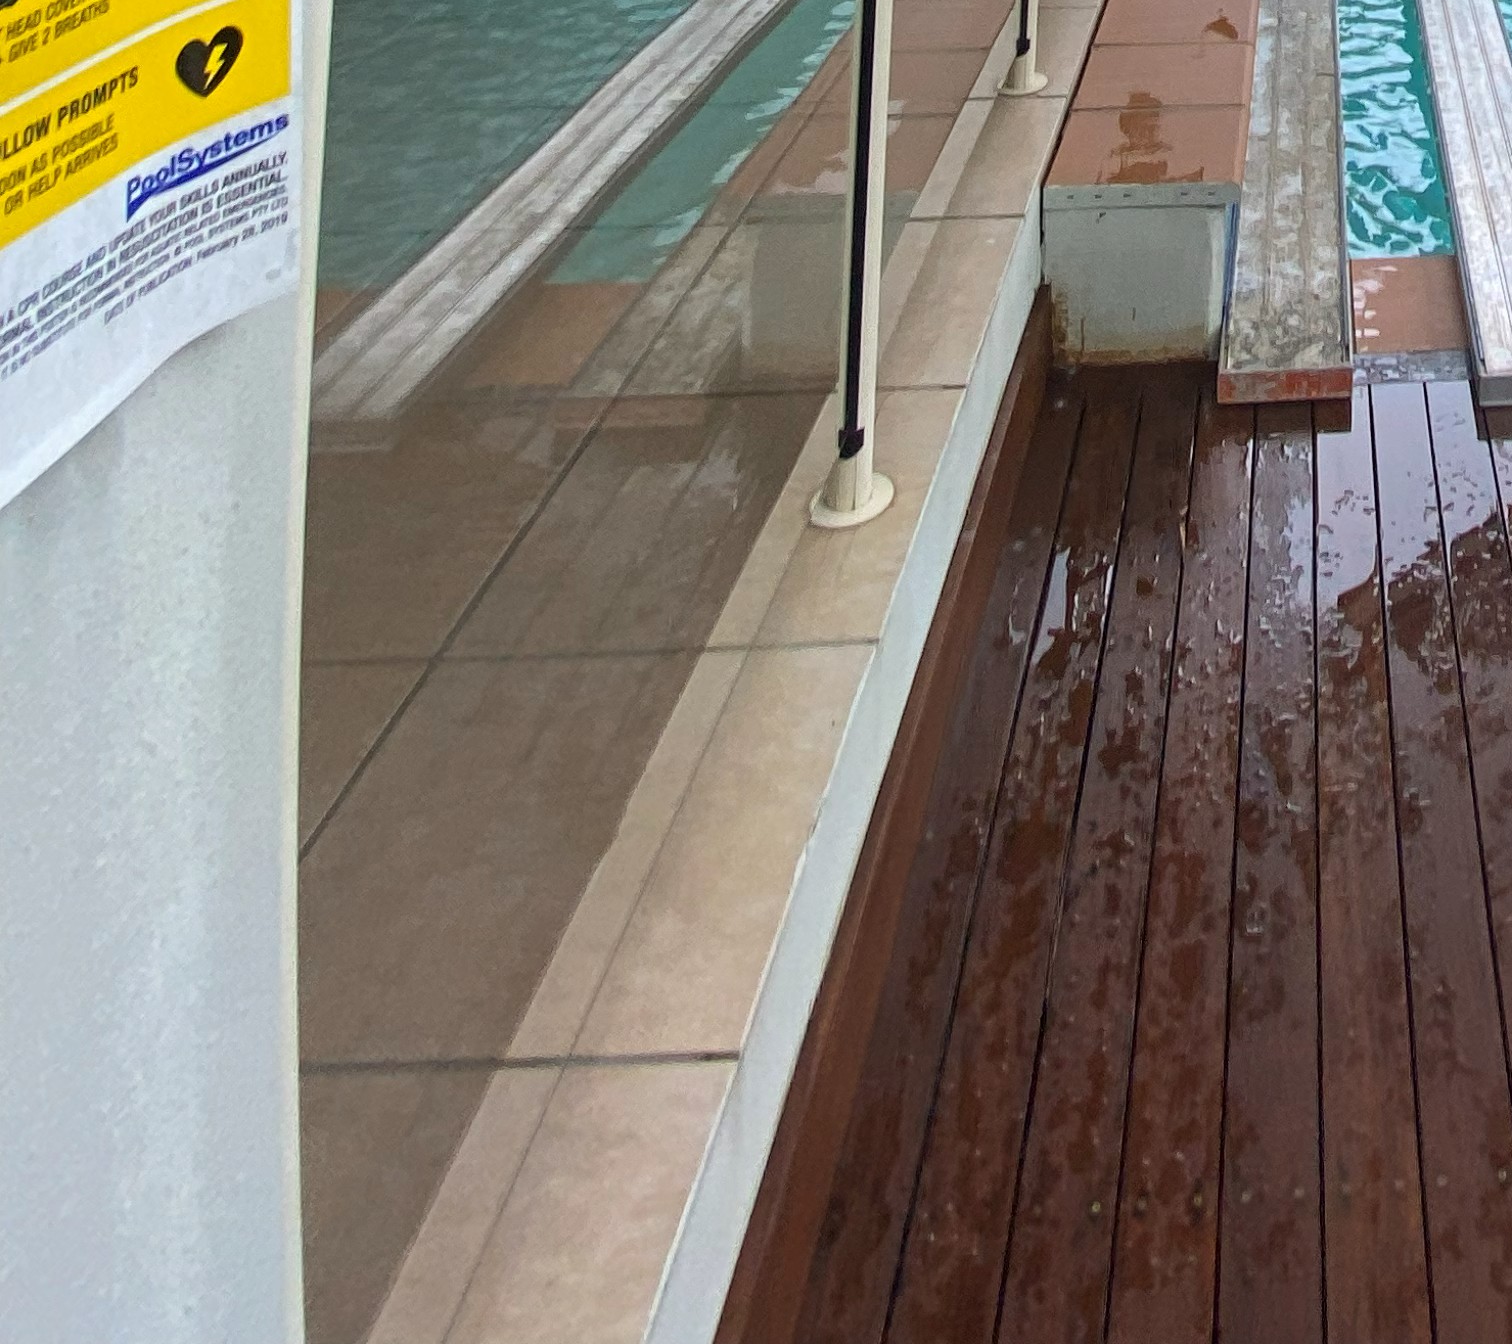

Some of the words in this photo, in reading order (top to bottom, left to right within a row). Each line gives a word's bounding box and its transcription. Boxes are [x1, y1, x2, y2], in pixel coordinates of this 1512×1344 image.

[6, 9, 41, 41] HEAD
[8, 32, 39, 62] GIVE
[42, 26, 51, 46] 2
[57, 64, 139, 130] PROMPTS
[28, 165, 62, 202] HELP
[64, 131, 119, 181] ARRIVES
[30, 152, 48, 179] AS
[52, 112, 115, 165] POSSIBLE
[126, 113, 289, 205] PoolSystems
